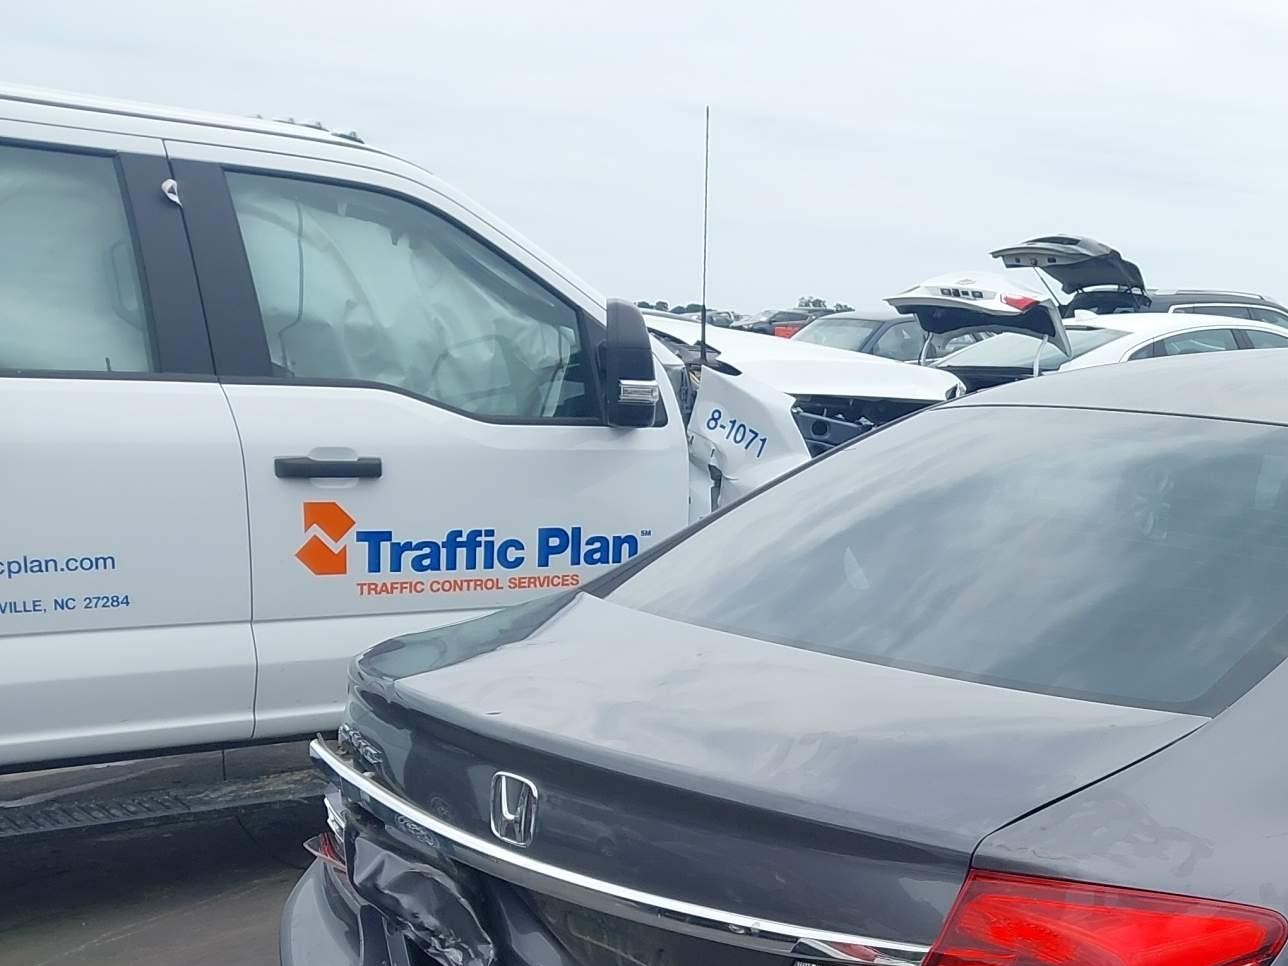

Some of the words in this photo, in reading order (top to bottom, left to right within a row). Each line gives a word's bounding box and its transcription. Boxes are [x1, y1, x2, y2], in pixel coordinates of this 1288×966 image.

[706, 409, 768, 458] 8-1071
[356, 528, 525, 573] Traffic
[537, 526, 639, 568] Plan
[356, 581, 425, 595] TRAFFIC
[430, 578, 504, 593] CONTROL
[508, 574, 580, 589] SERVICES
[53, 598, 76, 611] NC
[84, 595, 130, 609] 27284
